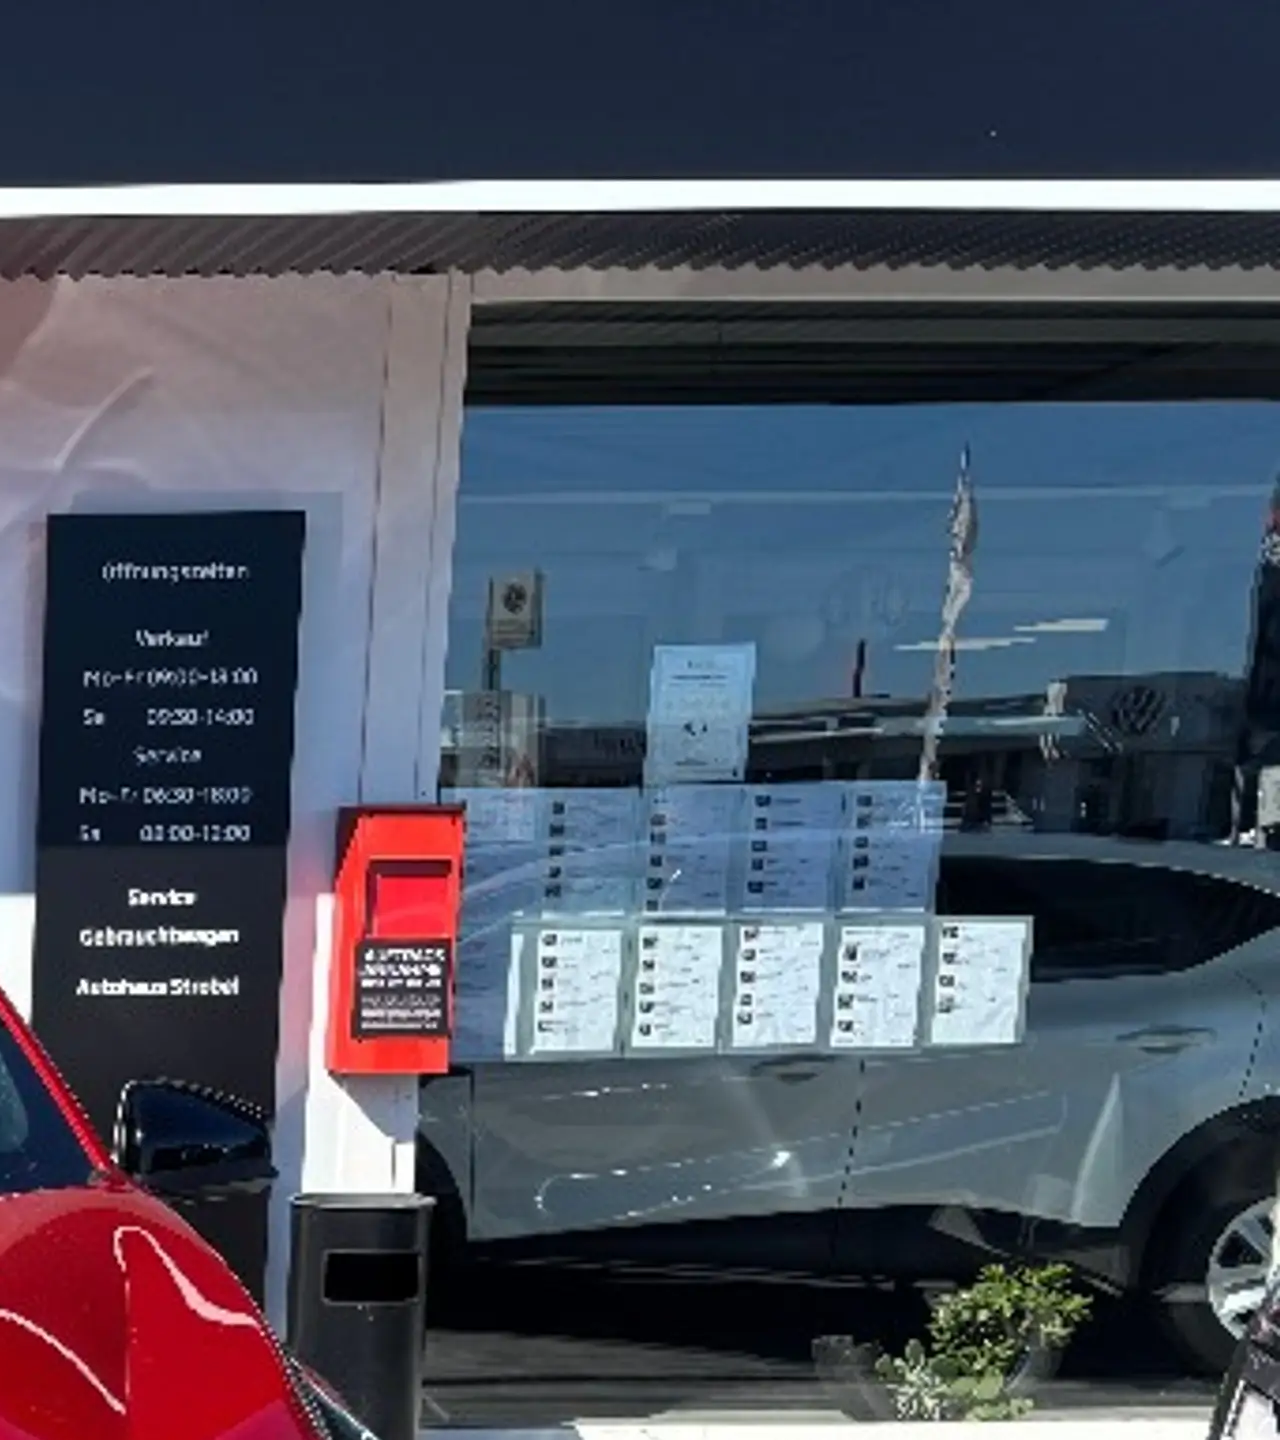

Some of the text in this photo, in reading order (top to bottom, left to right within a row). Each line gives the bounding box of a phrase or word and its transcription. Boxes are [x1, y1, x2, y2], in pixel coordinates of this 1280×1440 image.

[128, 888, 197, 906] Service
[79, 926, 240, 947] Gebrauchtwagen
[76, 975, 240, 996] Autohaus Strobel
